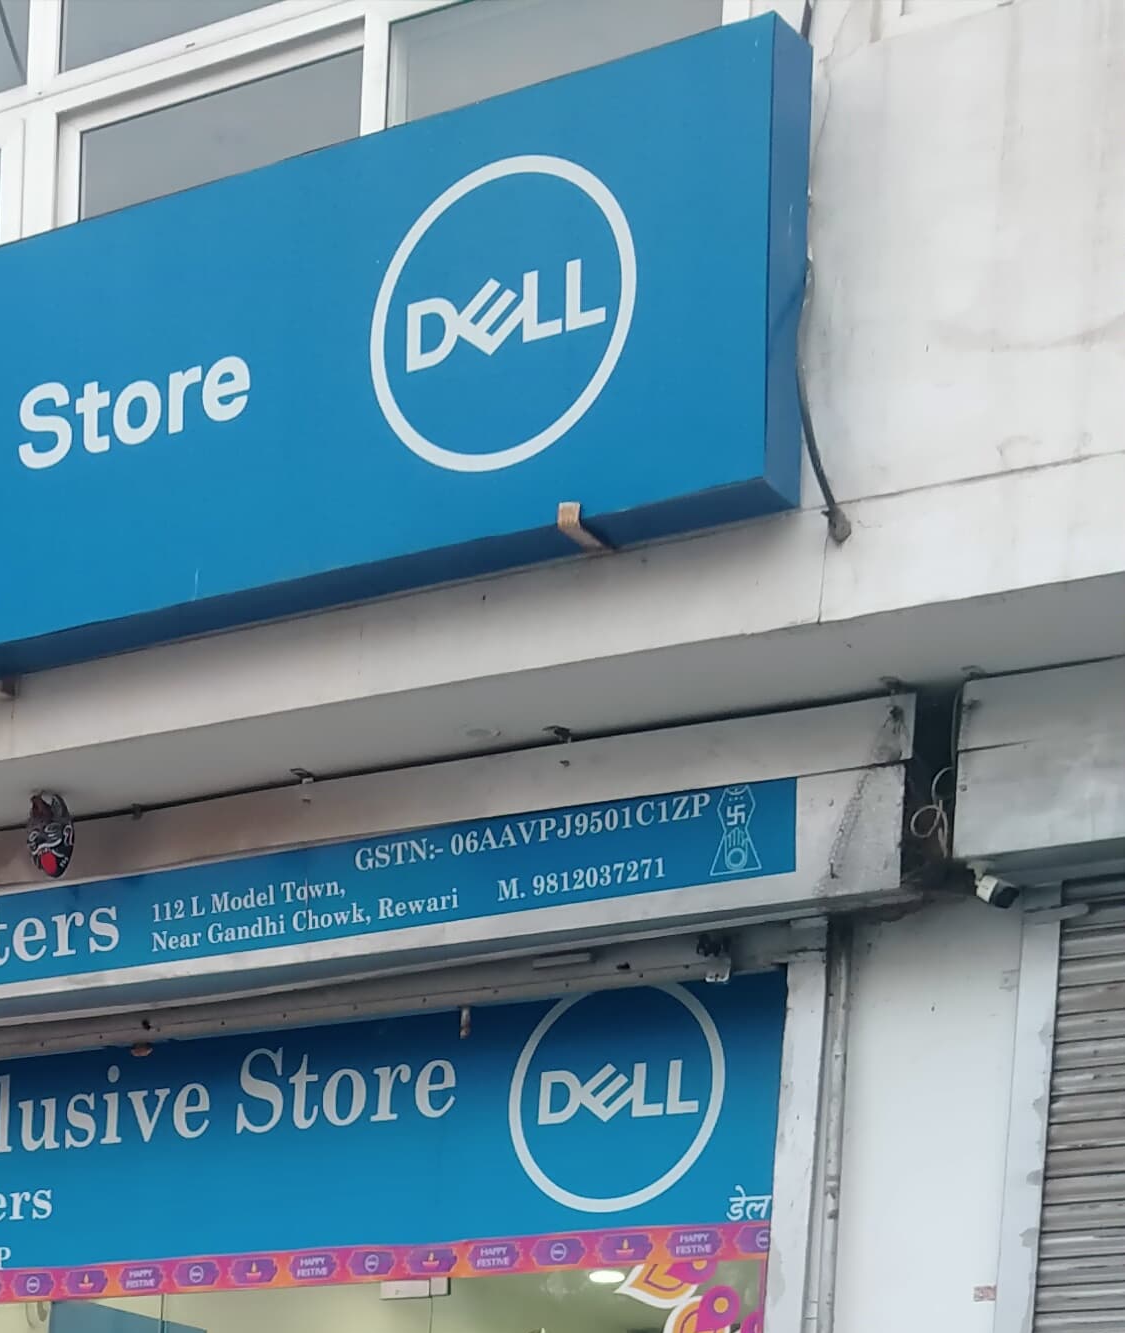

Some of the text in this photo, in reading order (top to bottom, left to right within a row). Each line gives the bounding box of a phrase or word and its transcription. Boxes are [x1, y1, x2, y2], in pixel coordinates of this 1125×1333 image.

[405, 257, 607, 374] DELL
[17, 354, 252, 470] Store
[354, 793, 711, 871] GSTN:- 06AAVPJ9501C1ZP
[151, 879, 347, 923] 112 L Model Town,
[497, 857, 667, 902] M. 9812037271
[151, 887, 459, 953] Near Gandhi Chowk, Rewari
[234, 1047, 458, 1136] Store
[536, 1058, 700, 1127] DELL
[726, 1185, 772, 1221] डेल
[480, 1245, 507, 1257] HAPPY
[675, 1243, 713, 1255] FESTIVE
[679, 1232, 709, 1244] HAPPY
[296, 1266, 329, 1278] FESTIVE
[300, 1256, 326, 1267] HAPPY
[476, 1256, 511, 1268] FESTIVE
